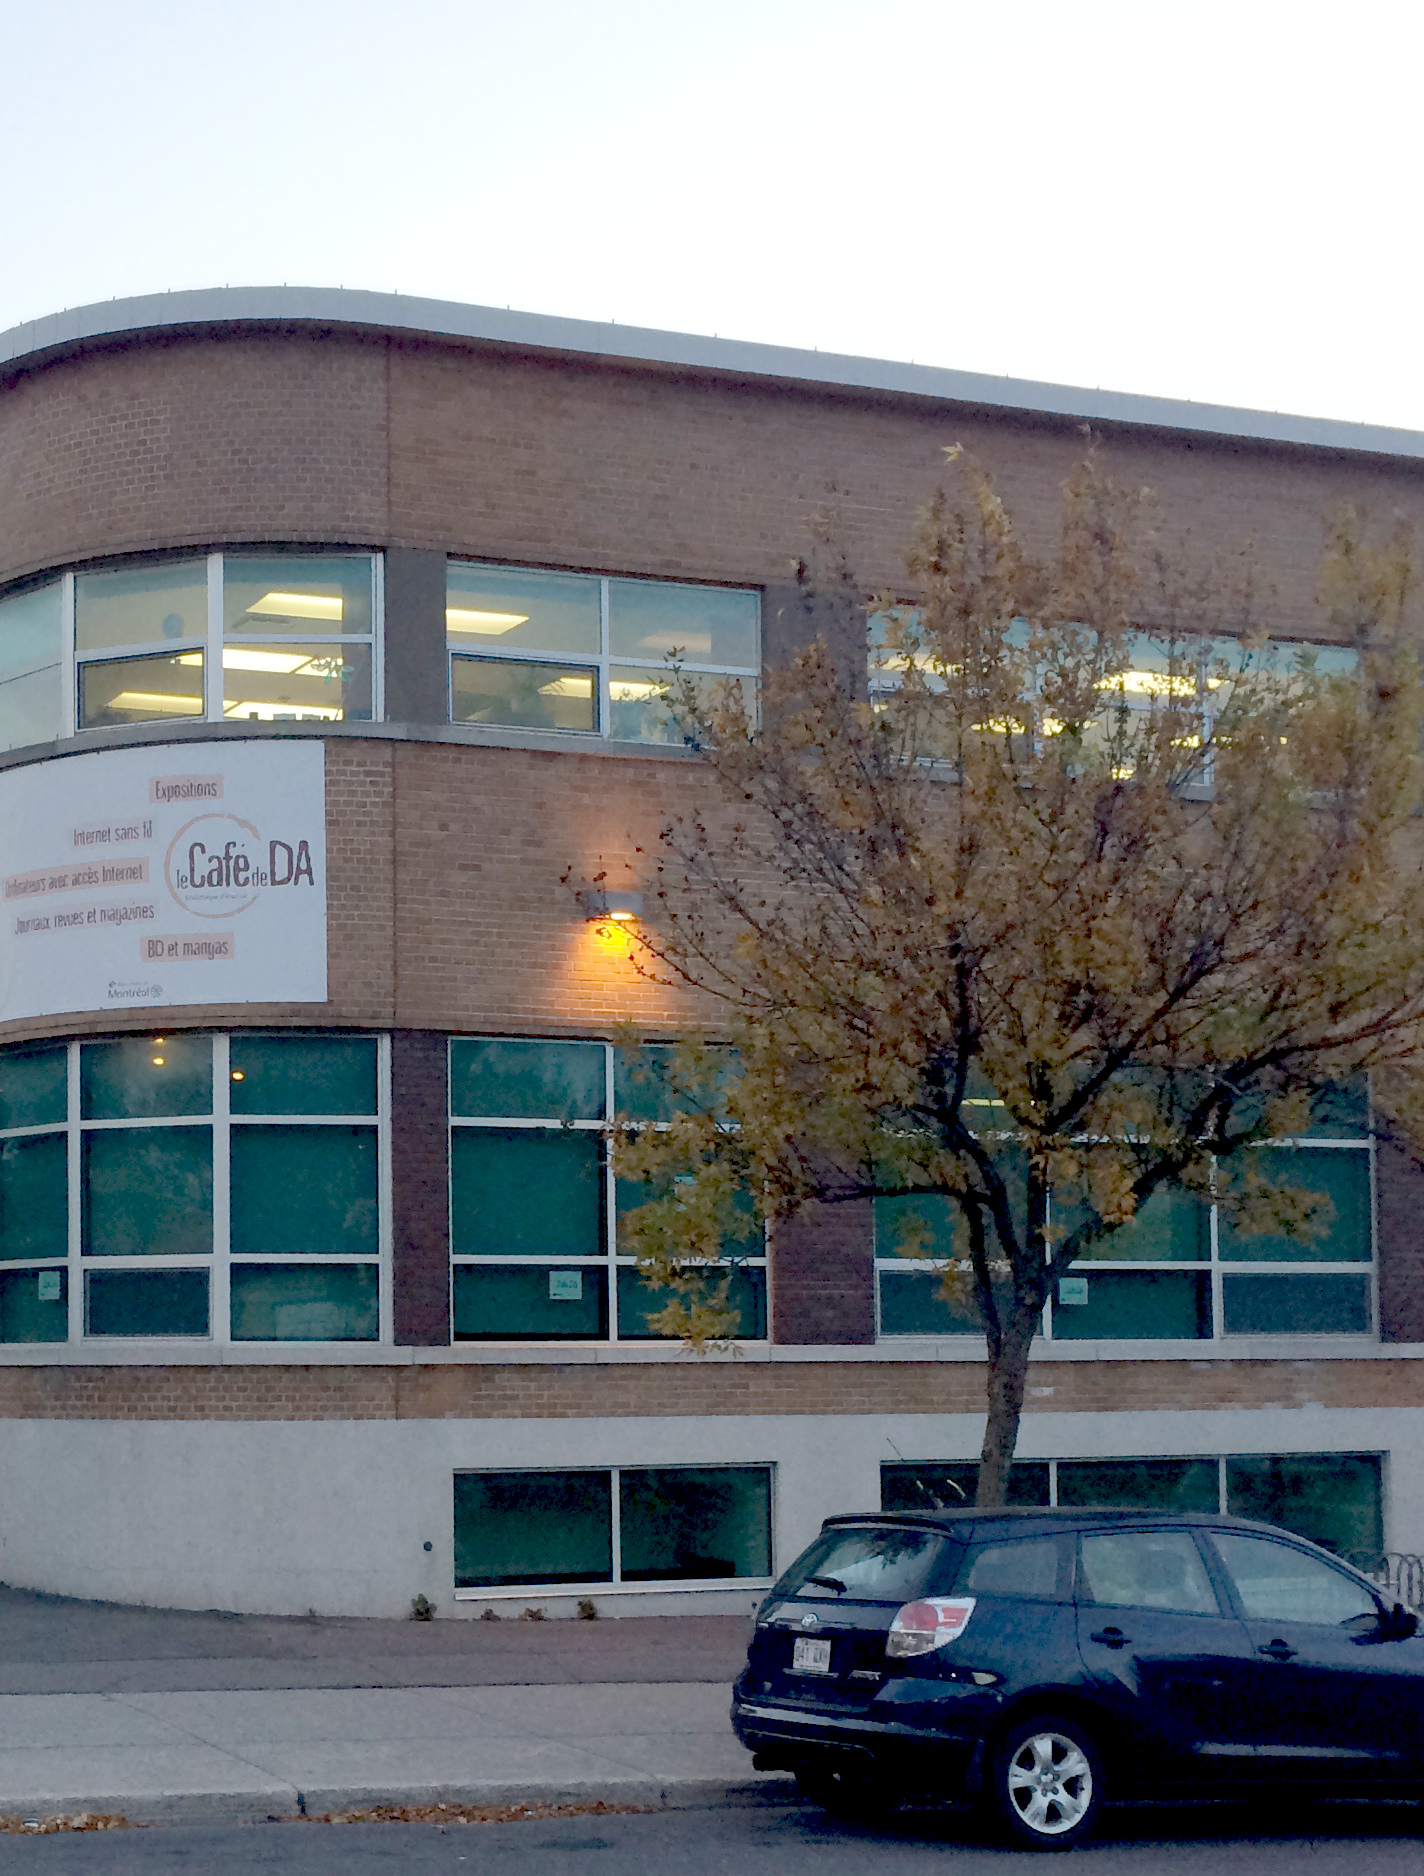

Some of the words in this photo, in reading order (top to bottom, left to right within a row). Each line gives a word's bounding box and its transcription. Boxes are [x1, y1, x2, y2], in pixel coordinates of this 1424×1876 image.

[155, 780, 217, 802] Expositions
[73, 827, 111, 847] Internet
[114, 824, 140, 842] sans
[143, 820, 153, 839] fil
[48, 874, 68, 890] avec
[71, 867, 99, 886] accès
[102, 864, 143, 882] Internet
[176, 868, 189, 889] le
[189, 841, 250, 888] Café
[251, 866, 268, 887] de
[269, 840, 315, 886] DA
[54, 911, 84, 928] revues
[87, 907, 97, 924] et
[100, 902, 155, 926] magazines
[147, 939, 165, 958] BD
[167, 941, 179, 957] et
[182, 941, 229, 961] mangas
[107, 987, 150, 999] Montréal
